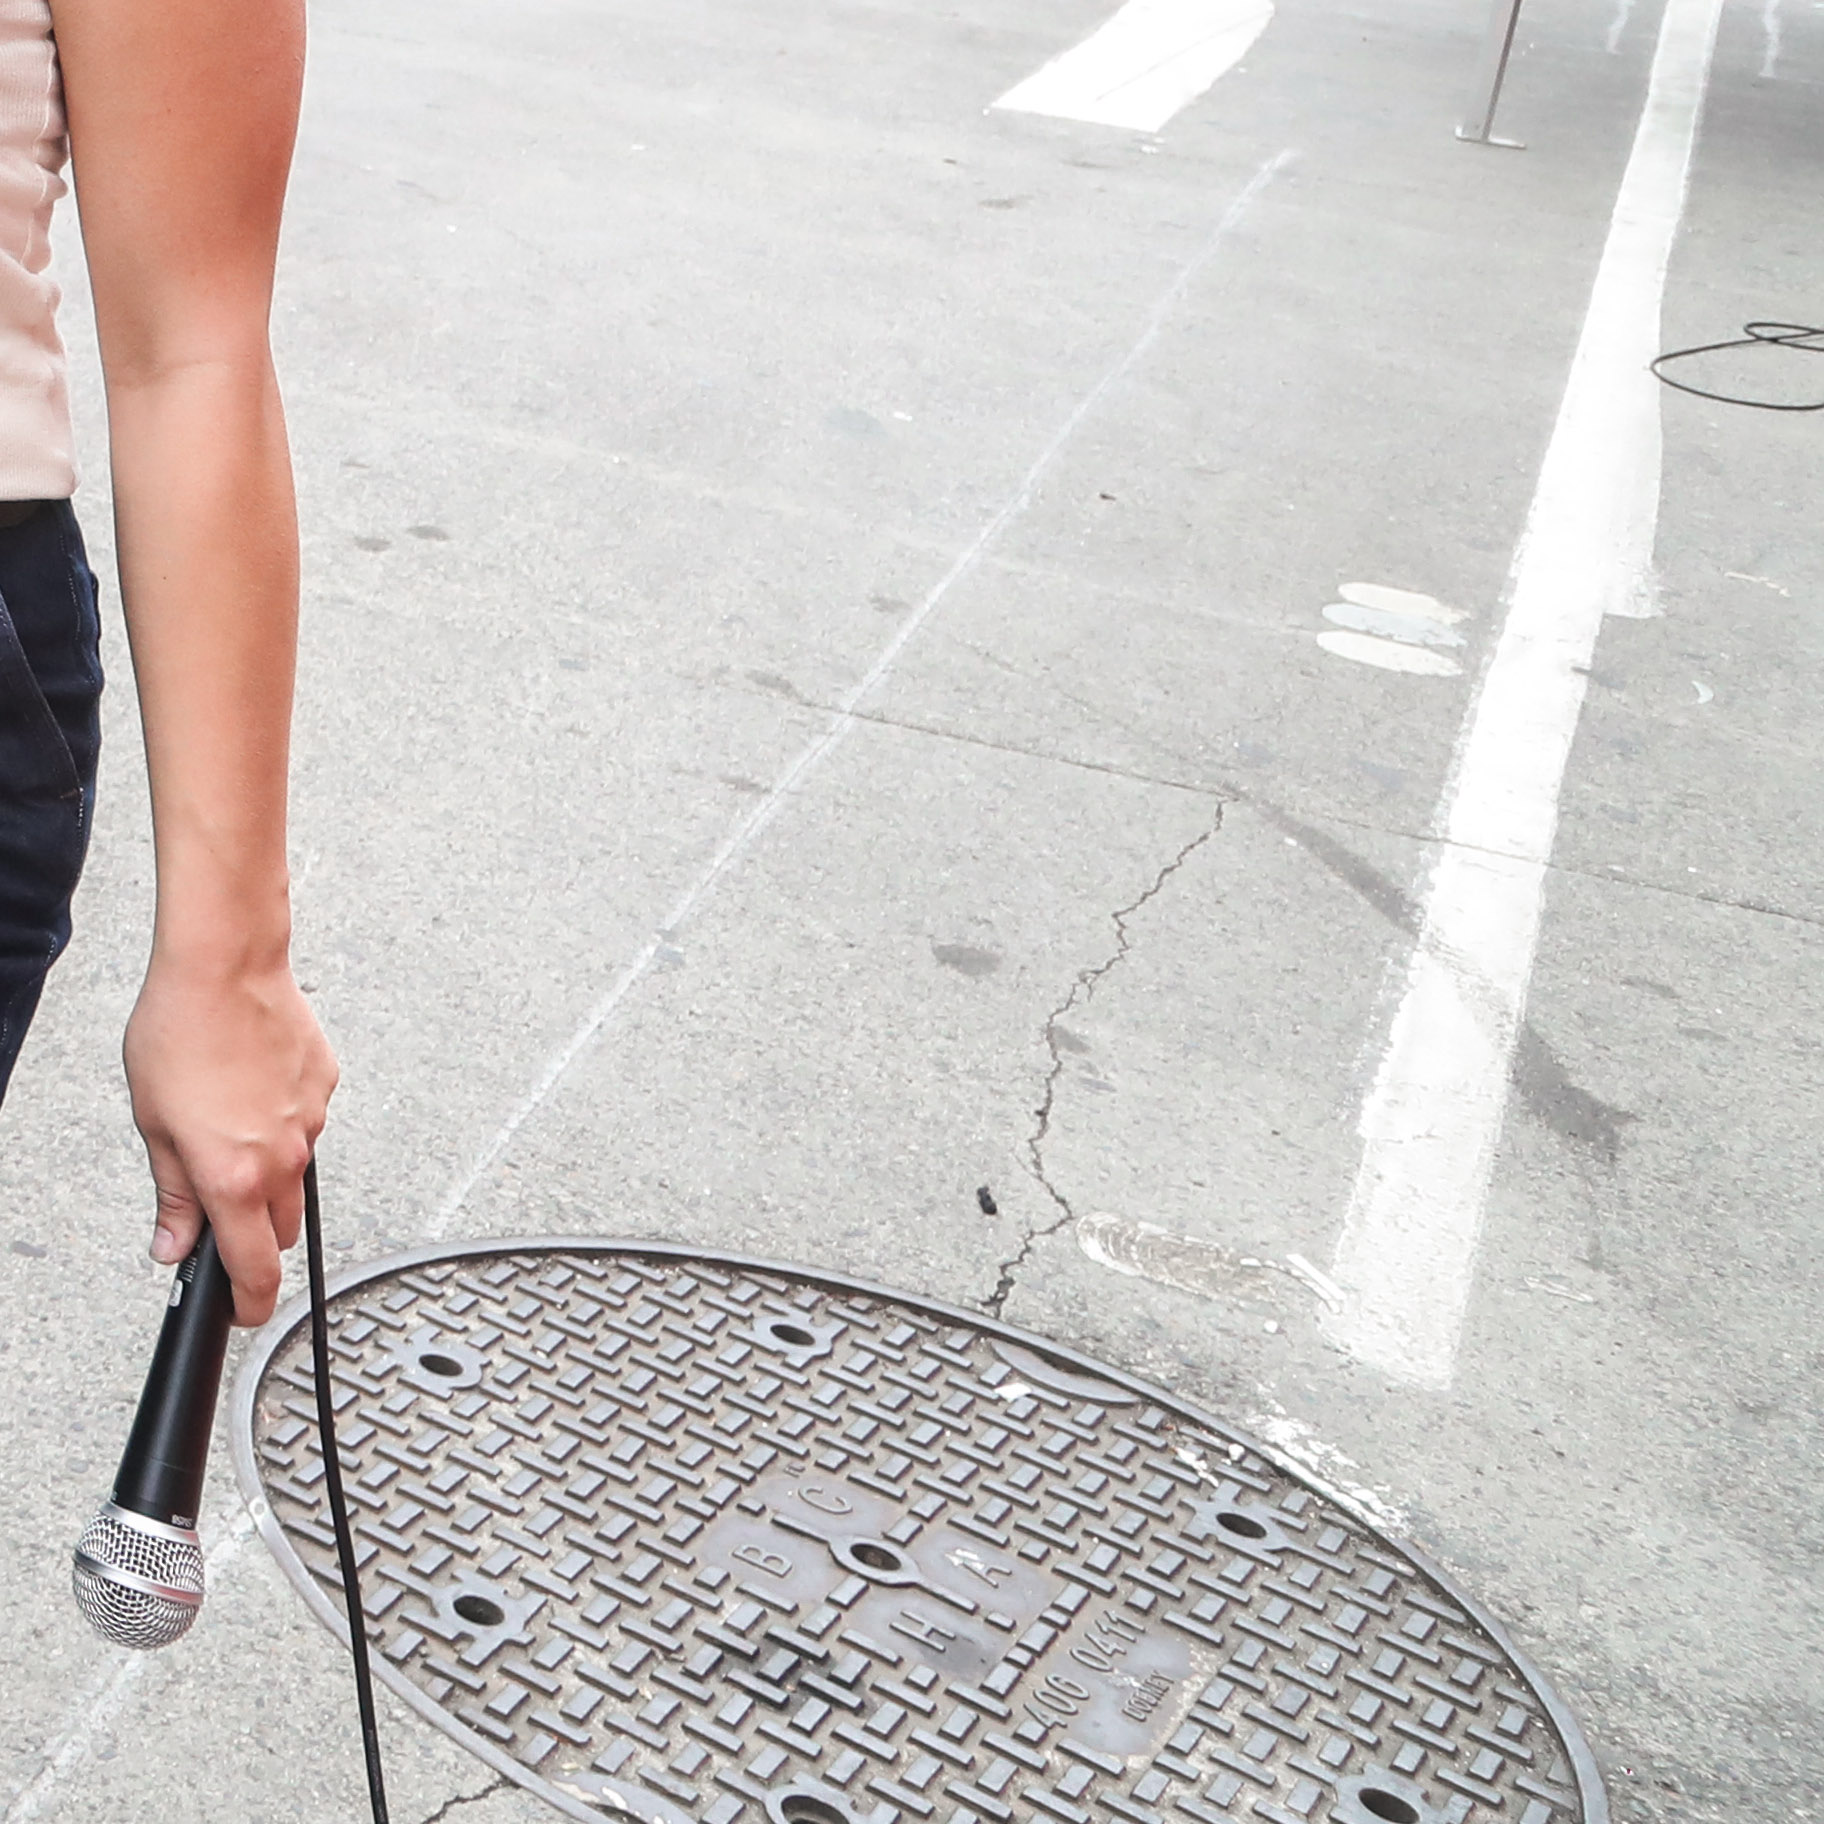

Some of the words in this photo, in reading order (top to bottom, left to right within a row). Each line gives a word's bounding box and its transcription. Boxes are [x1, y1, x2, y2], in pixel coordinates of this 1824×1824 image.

[890, 1609, 956, 1652] H
[1022, 1674, 1091, 1730] 406
[1068, 1609, 1146, 1673] 0411
